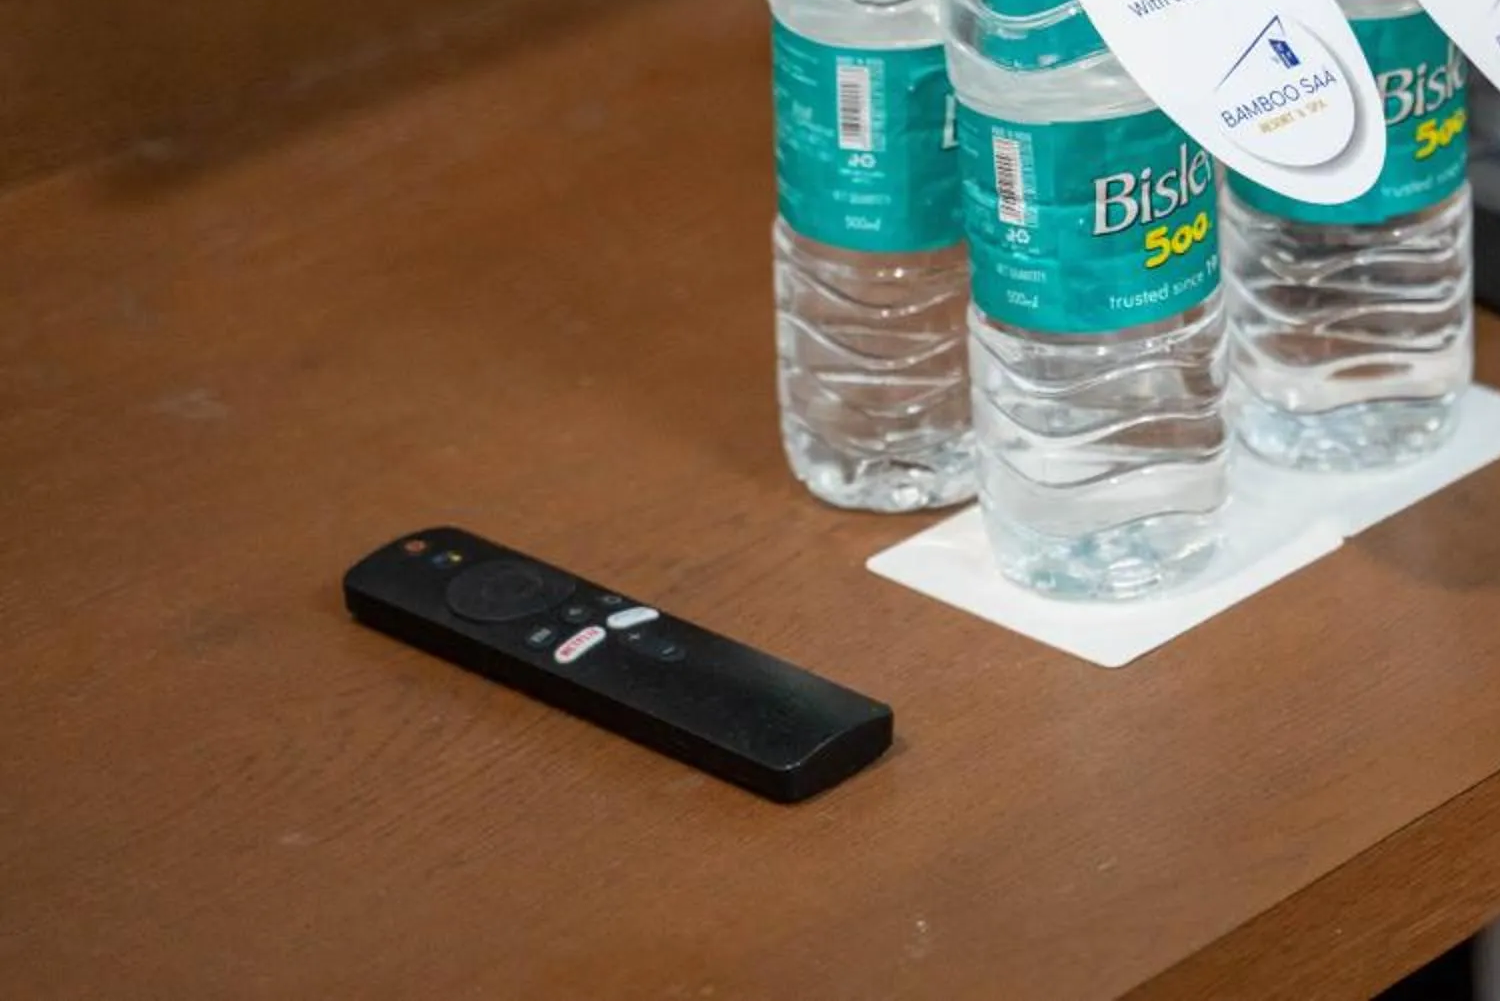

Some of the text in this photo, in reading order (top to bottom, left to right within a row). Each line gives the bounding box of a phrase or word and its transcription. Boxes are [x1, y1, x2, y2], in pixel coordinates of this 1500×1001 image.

[1221, 70, 1337, 128] BAMBOO SAA
[1093, 142, 1212, 236] Bisle
[1145, 211, 1209, 268] 500
